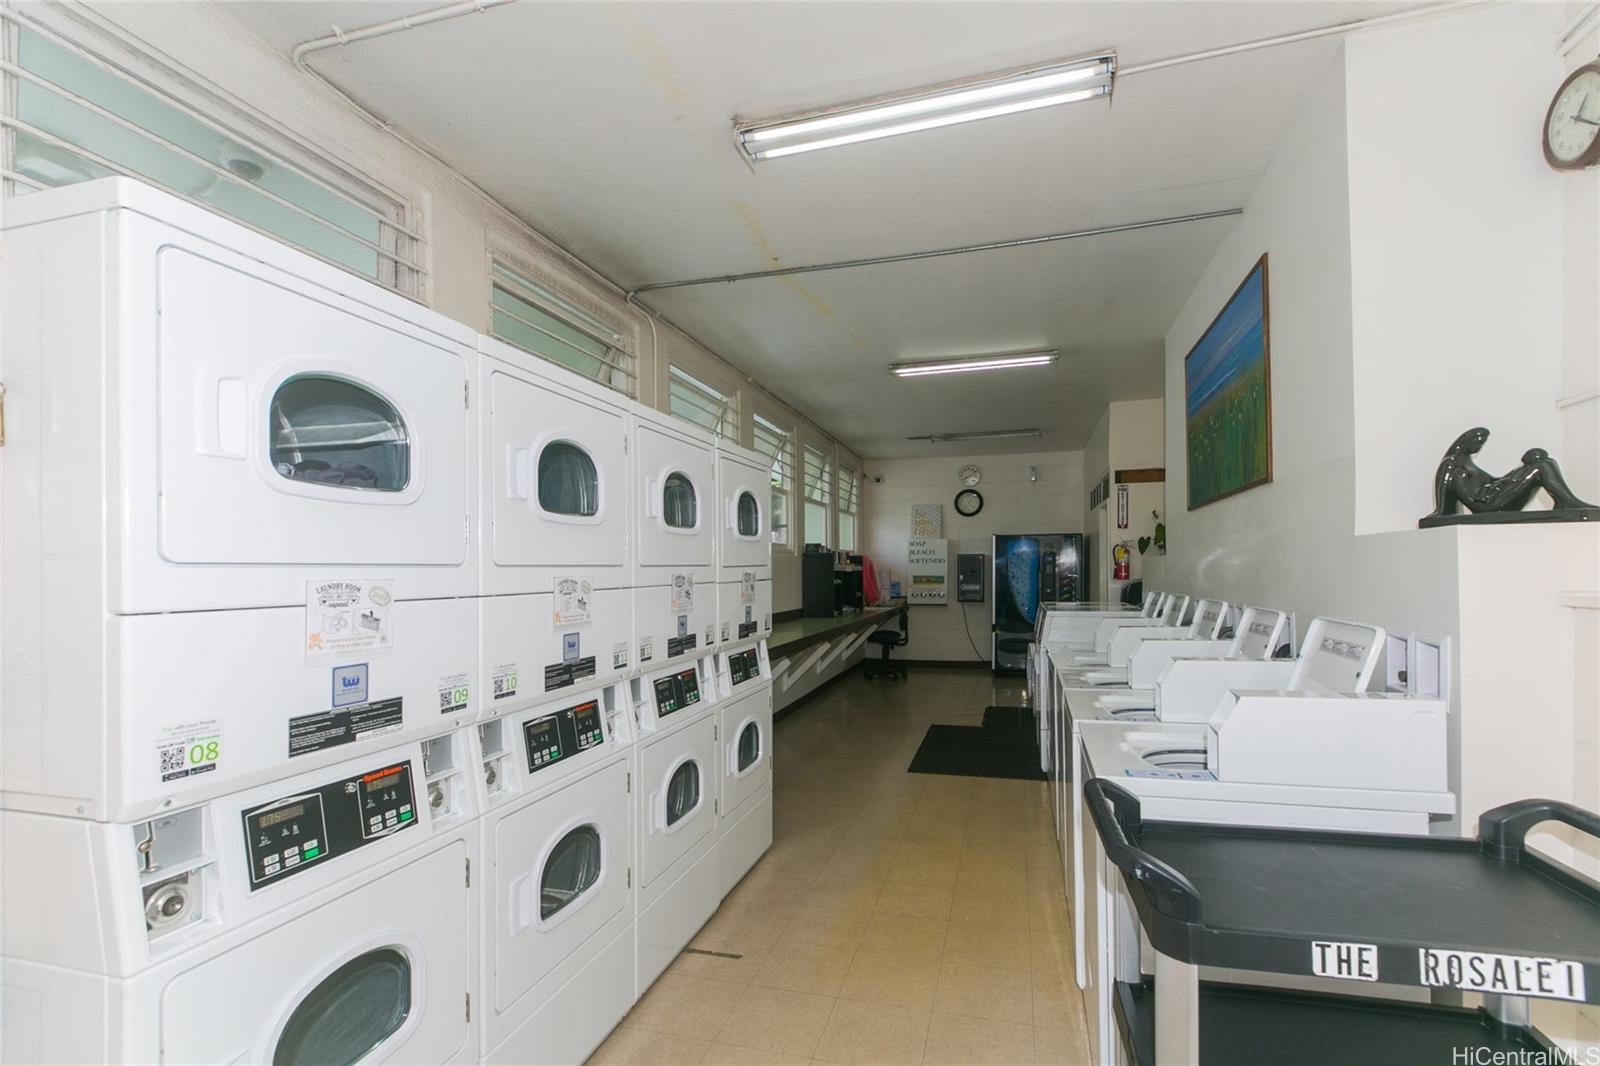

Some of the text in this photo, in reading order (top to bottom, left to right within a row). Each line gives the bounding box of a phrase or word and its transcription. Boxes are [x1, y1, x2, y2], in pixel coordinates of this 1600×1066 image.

[315, 582, 362, 594] LAUNDRY ROOM
[506, 676, 517, 690] 10
[453, 688, 469, 704] 09
[190, 741, 219, 764] 08
[1315, 943, 1373, 979] THE
